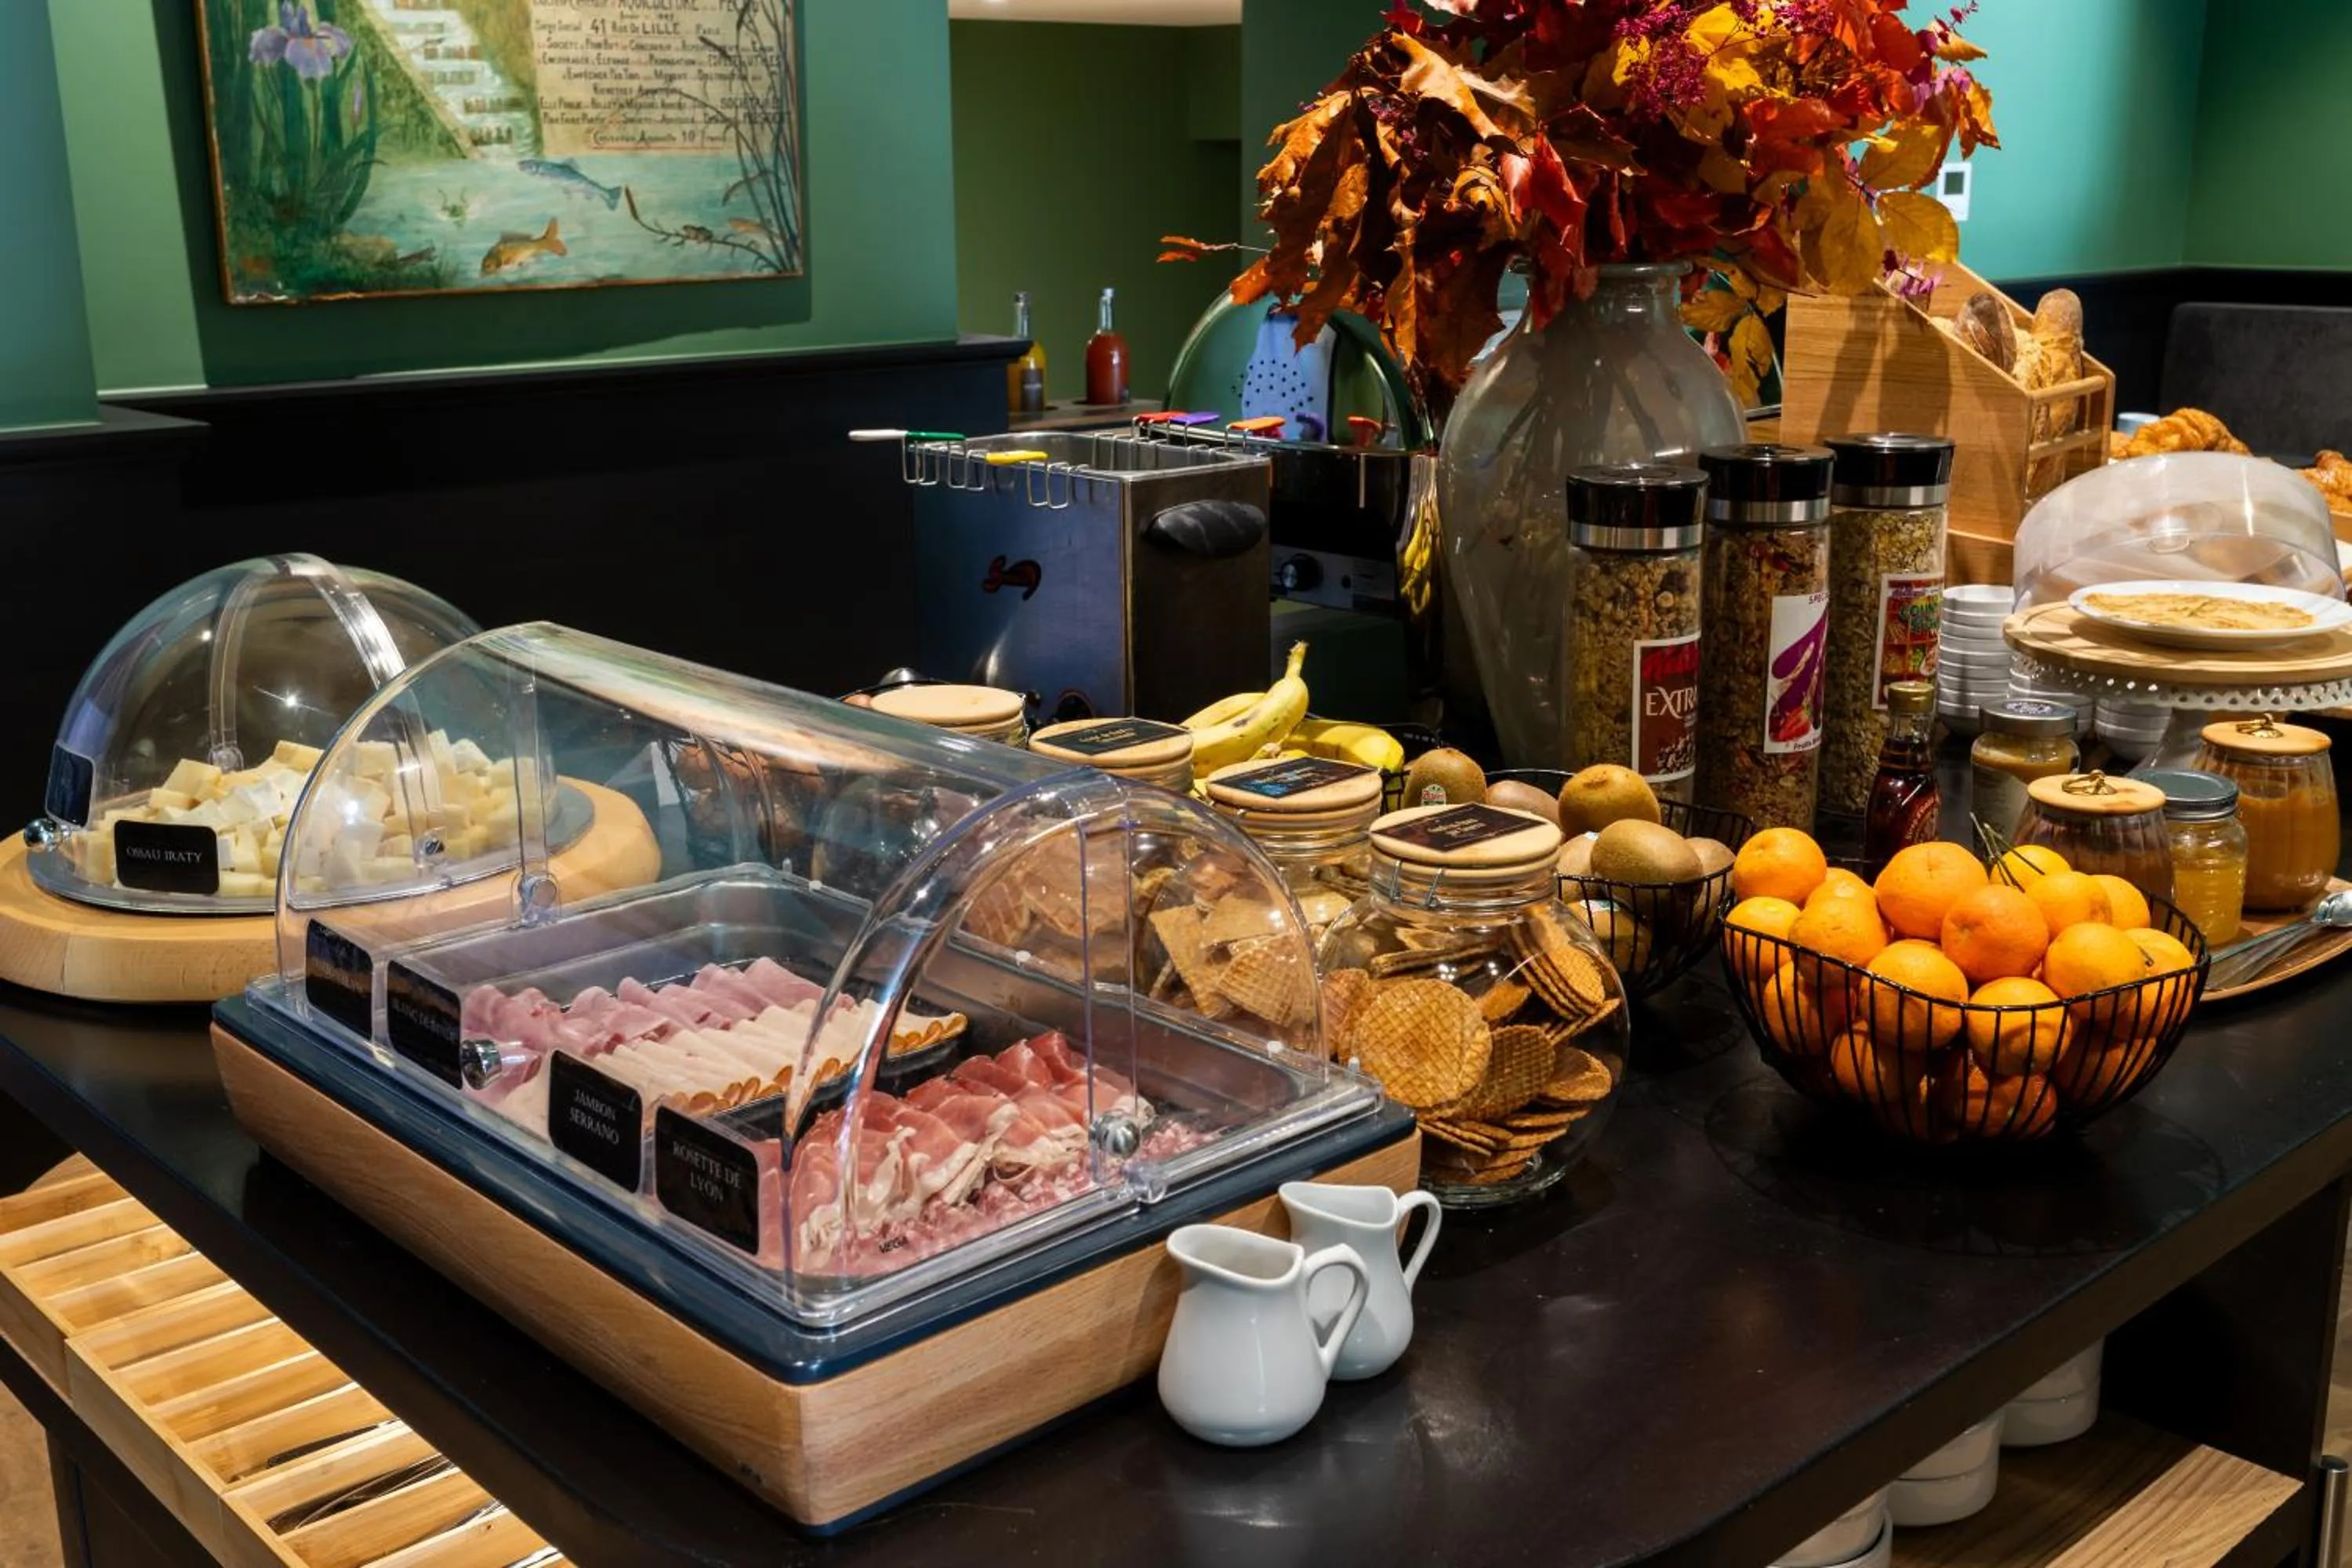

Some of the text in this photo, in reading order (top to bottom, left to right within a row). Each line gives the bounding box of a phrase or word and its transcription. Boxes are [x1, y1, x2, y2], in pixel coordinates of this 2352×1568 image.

[590, 18, 607, 37] 41
[641, 22, 681, 35] LILLE
[574, 1088, 617, 1121] JAMBON
[569, 1106, 620, 1146] SERRANO
[672, 1140, 723, 1178] ROSETTE
[690, 1171, 724, 1203] LYON
